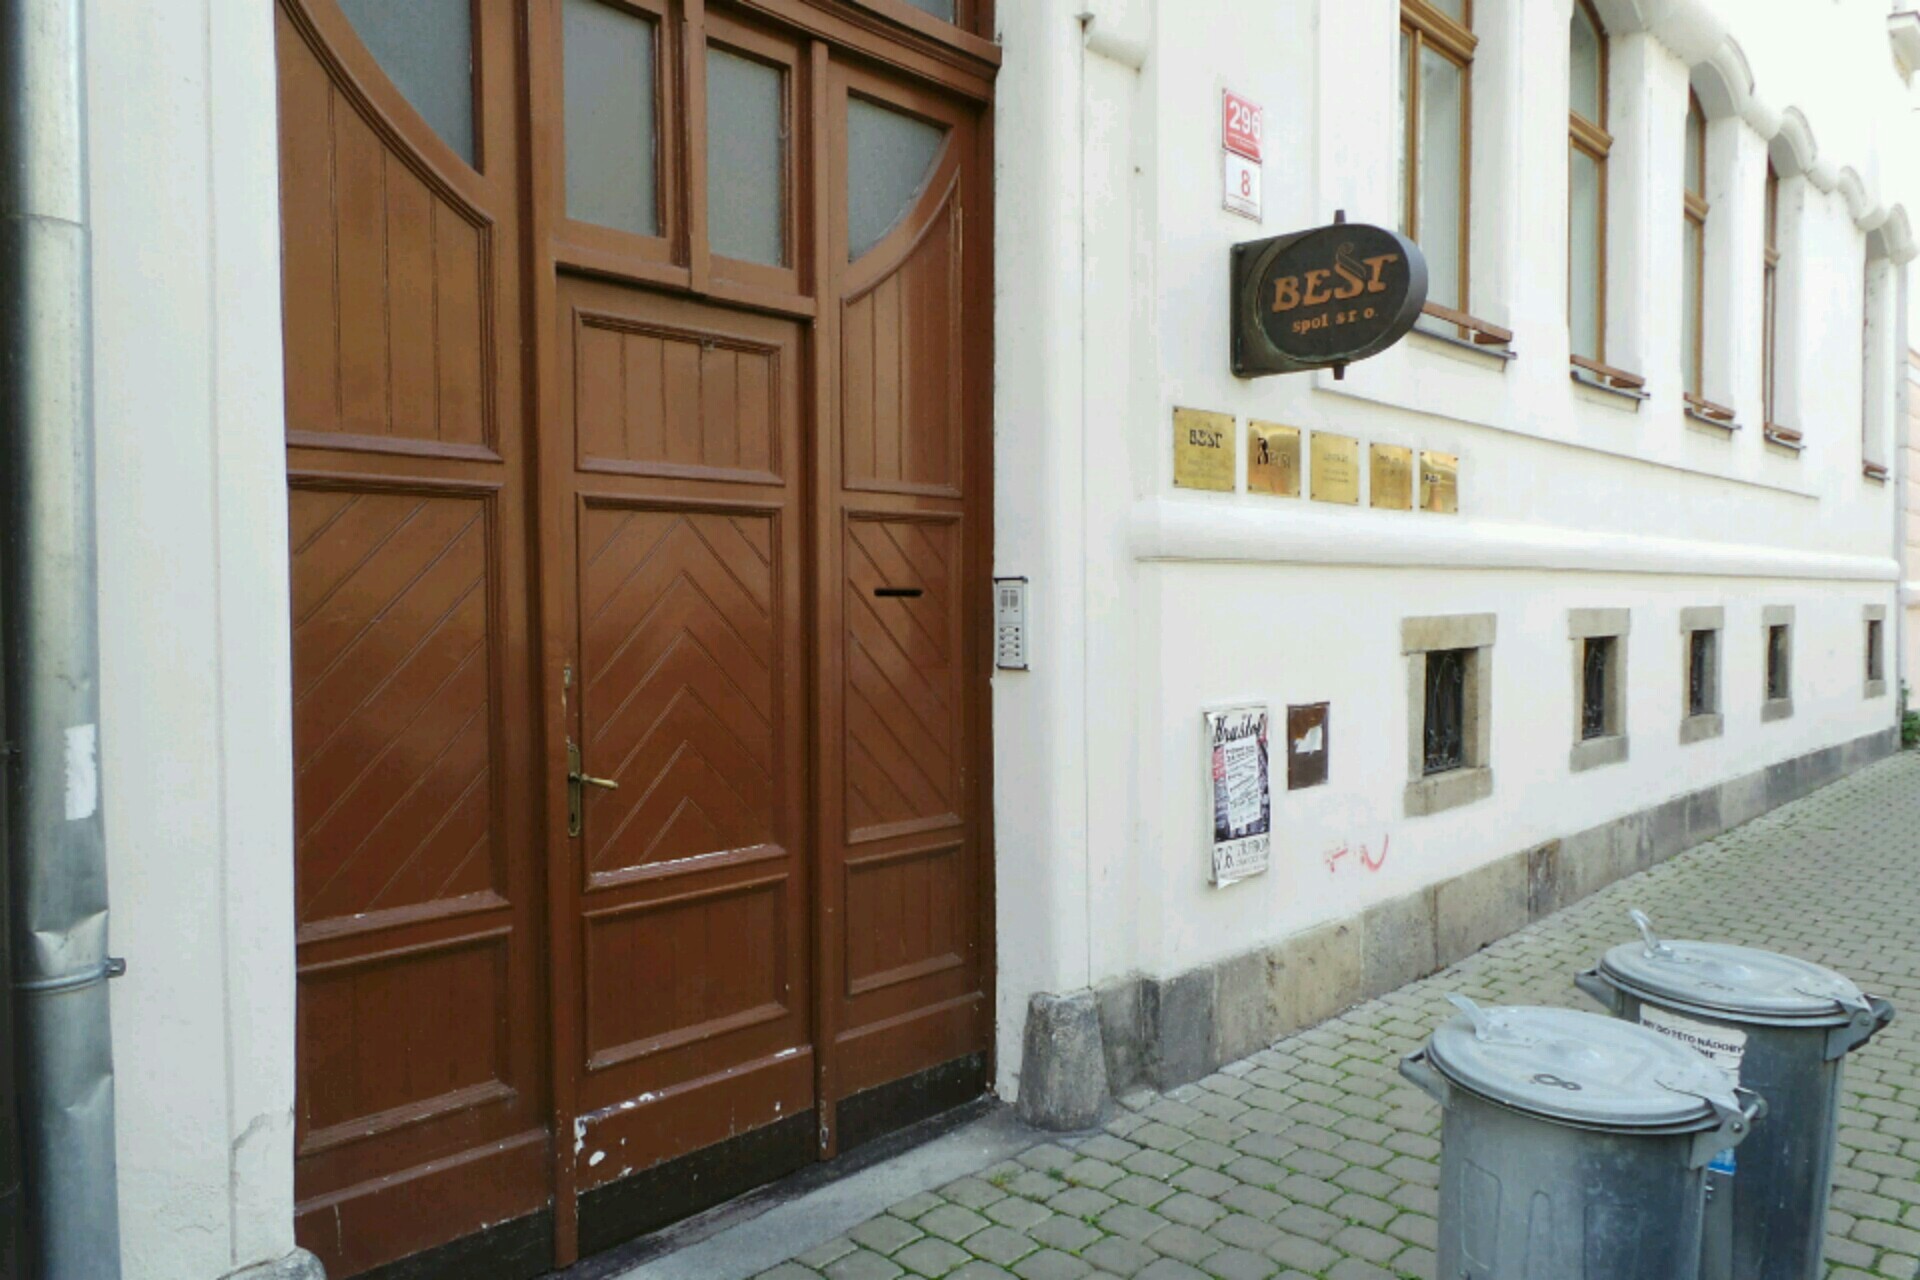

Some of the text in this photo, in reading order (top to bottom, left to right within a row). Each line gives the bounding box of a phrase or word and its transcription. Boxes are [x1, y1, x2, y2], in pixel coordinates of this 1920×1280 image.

[1228, 101, 1261, 140] 296
[1241, 169, 1251, 197] 8
[1271, 243, 1398, 313] BEST
[1189, 428, 1223, 449] BEST
